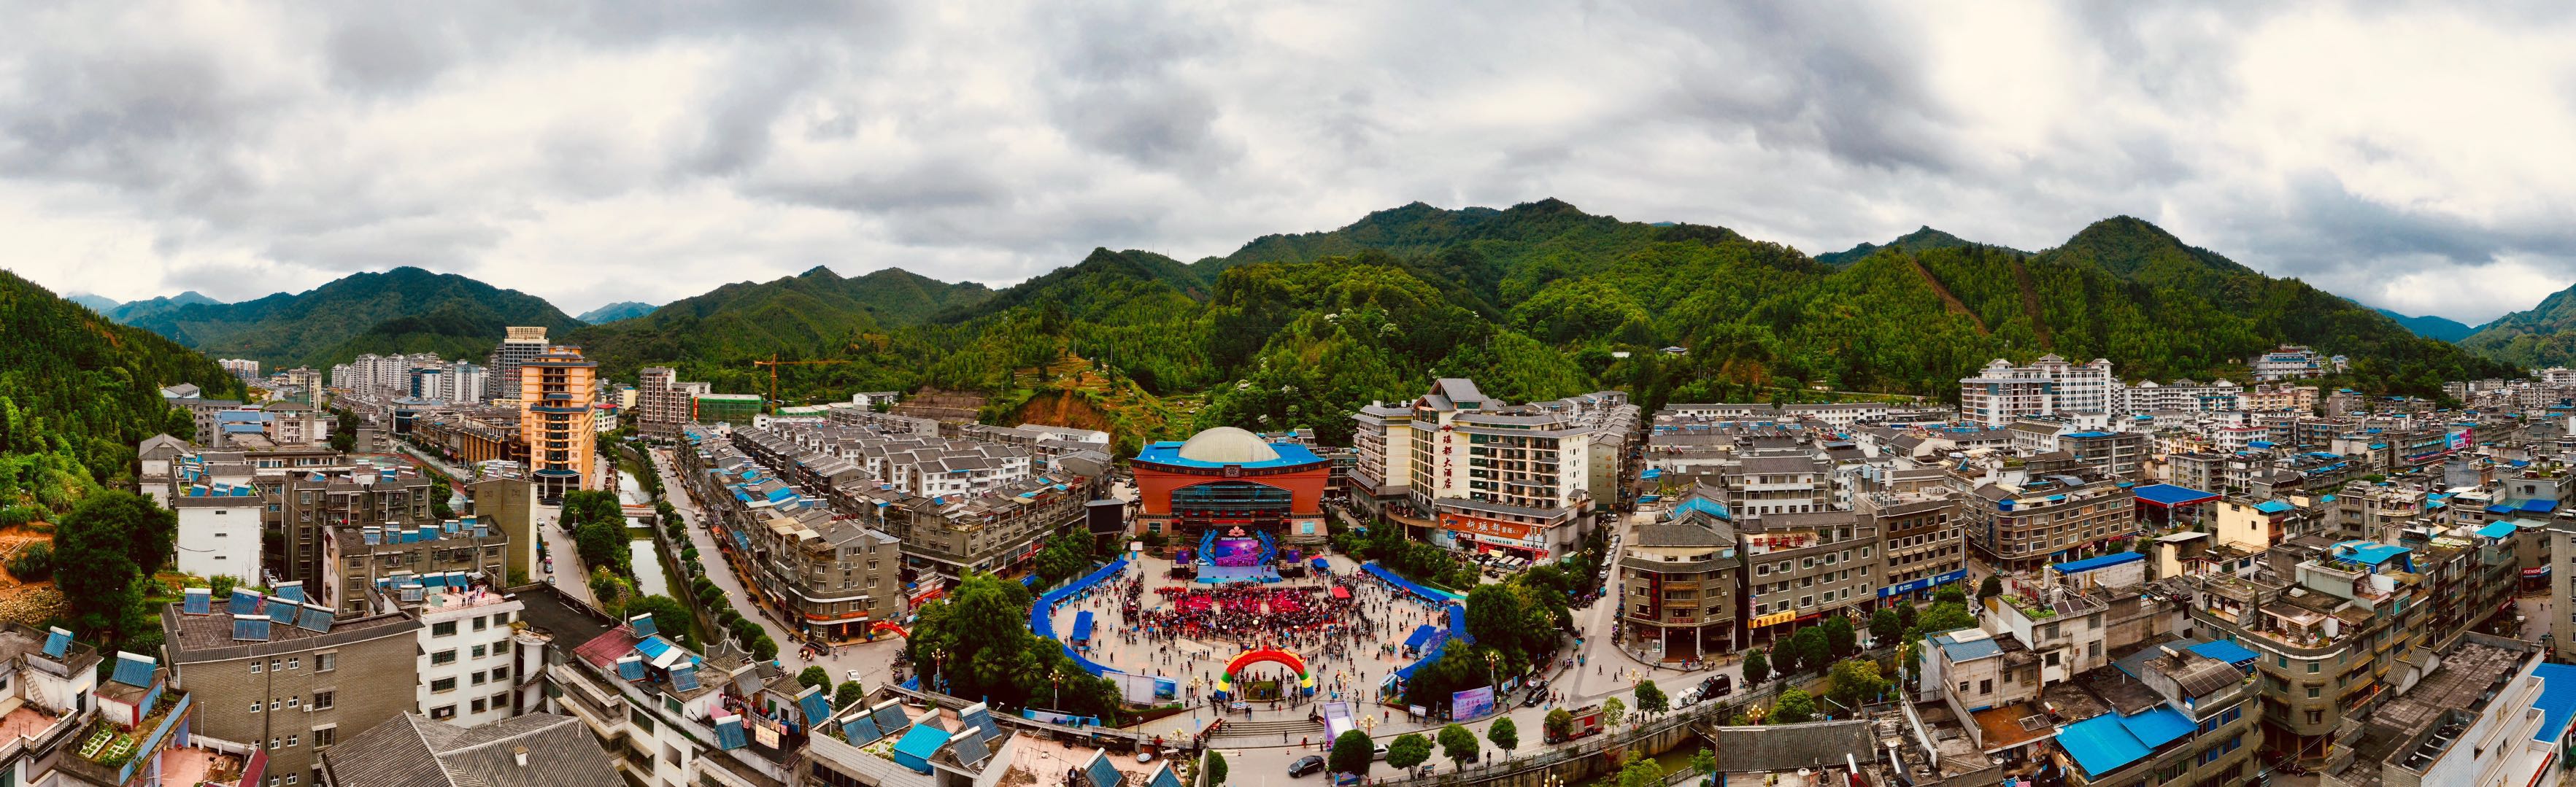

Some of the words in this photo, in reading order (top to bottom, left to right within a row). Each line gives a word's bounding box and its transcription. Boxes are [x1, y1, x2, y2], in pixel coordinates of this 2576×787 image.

[1443, 435, 1452, 489] 瑶都大酒店
